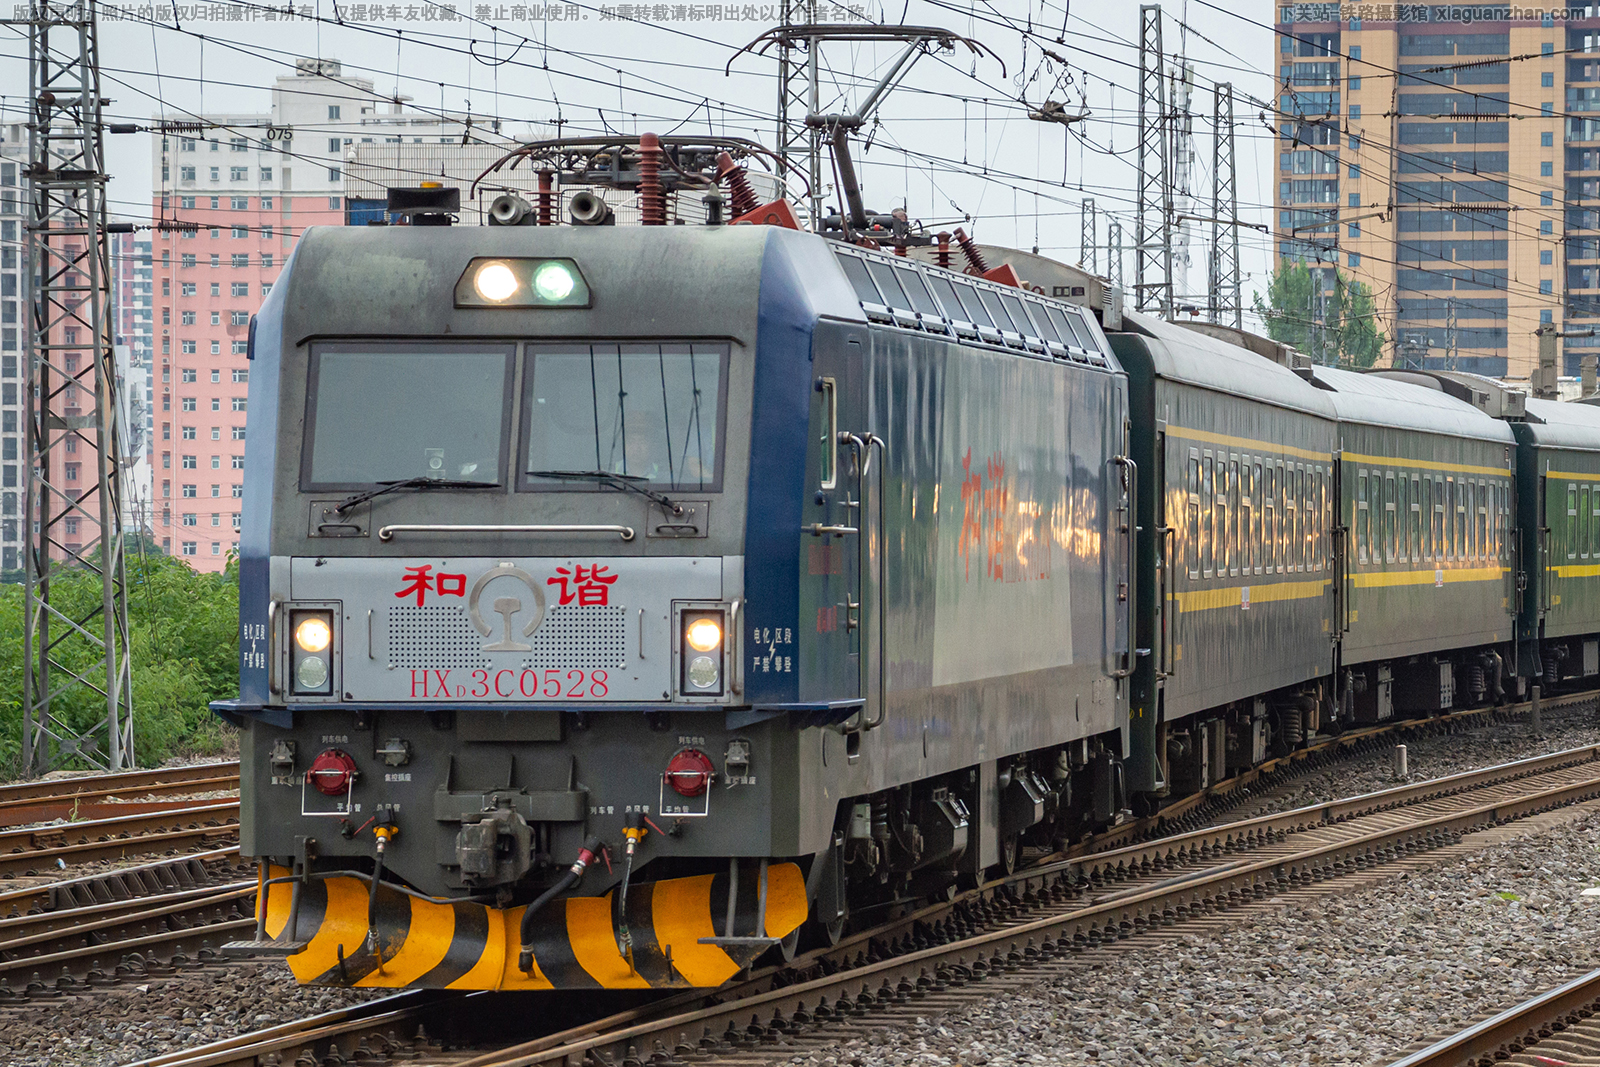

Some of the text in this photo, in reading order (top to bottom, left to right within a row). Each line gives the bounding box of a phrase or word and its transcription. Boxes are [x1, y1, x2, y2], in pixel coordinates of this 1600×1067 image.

[266, 128, 293, 140] 075
[753, 627, 792, 644] 电化区段
[752, 656, 792, 673] 严禁攀登
[589, 805, 615, 815] 列车管
